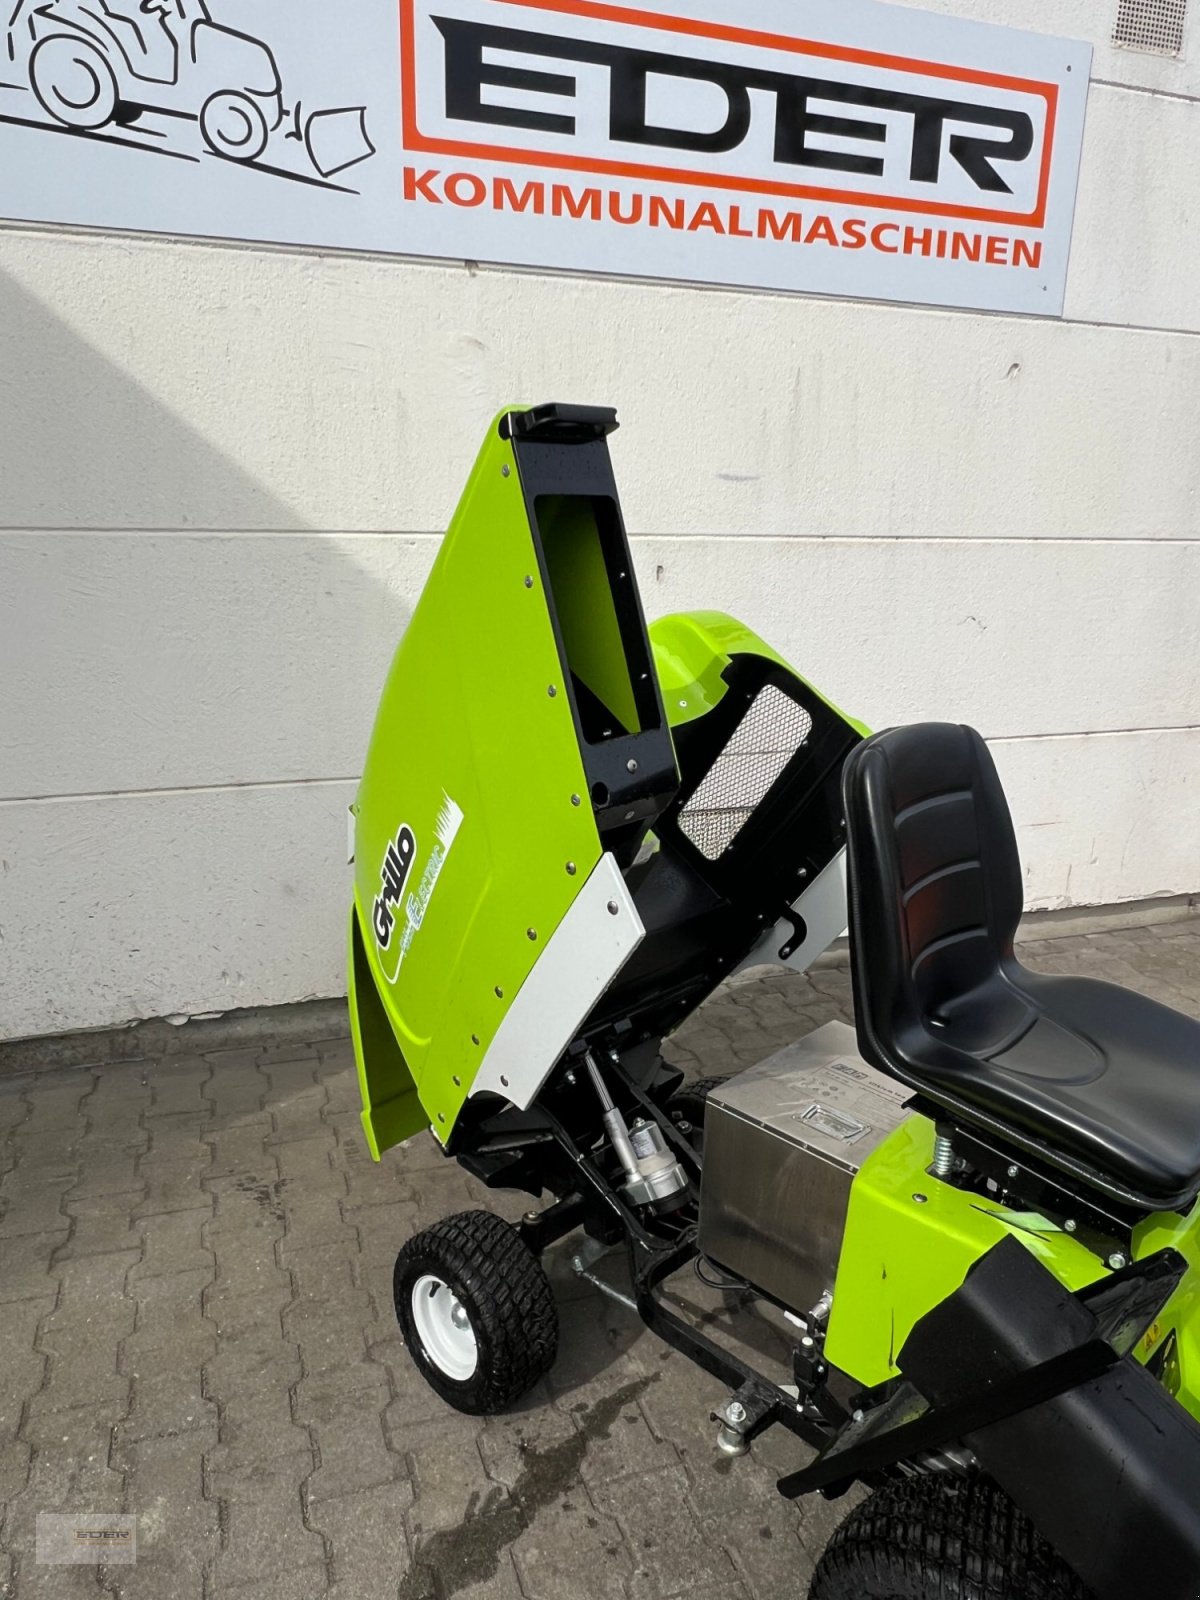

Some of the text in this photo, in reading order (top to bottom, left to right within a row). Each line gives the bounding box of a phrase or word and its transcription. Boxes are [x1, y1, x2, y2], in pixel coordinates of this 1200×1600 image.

[429, 14, 1034, 194] EDER
[403, 166, 1042, 268] KOMMUNALMASCHINEN
[373, 825, 416, 949] Grillo
